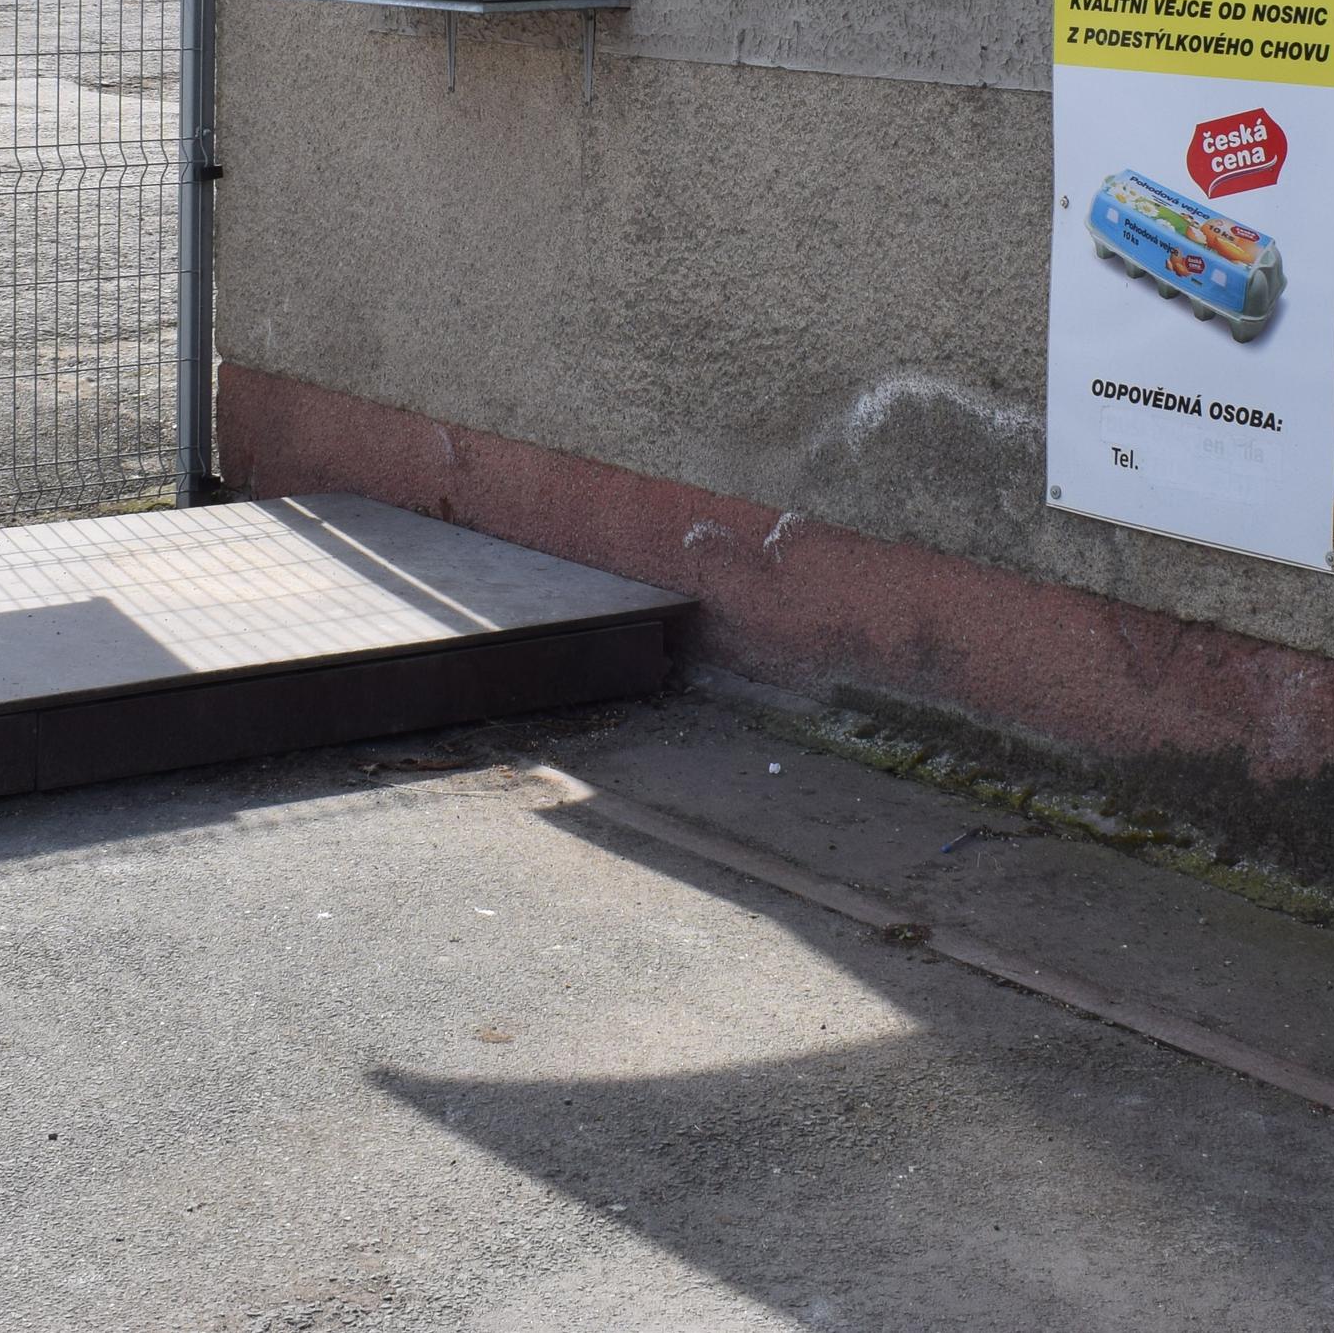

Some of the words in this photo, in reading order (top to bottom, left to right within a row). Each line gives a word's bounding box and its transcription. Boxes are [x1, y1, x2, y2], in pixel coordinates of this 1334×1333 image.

[1218, 2, 1246, 21] OD
[1252, 4, 1328, 26] NOSNIC
[1067, 26, 1079, 44] Z
[1083, 27, 1254, 56] PODESTÝLKOVÉHO
[1260, 40, 1330, 62] CHOVU
[1202, 118, 1268, 154] česká
[1211, 146, 1266, 172] cena
[1129, 175, 1179, 205] Pohodová
[1122, 230, 1131, 240] 10
[1131, 234, 1139, 246] ks
[1124, 218, 1159, 245] Pohodová
[1159, 240, 1179, 257] vejce
[1091, 378, 1203, 417] ODPOVĚDNÁ
[1209, 401, 1283, 432] OSOBA:
[1111, 447, 1139, 470] Tel.
